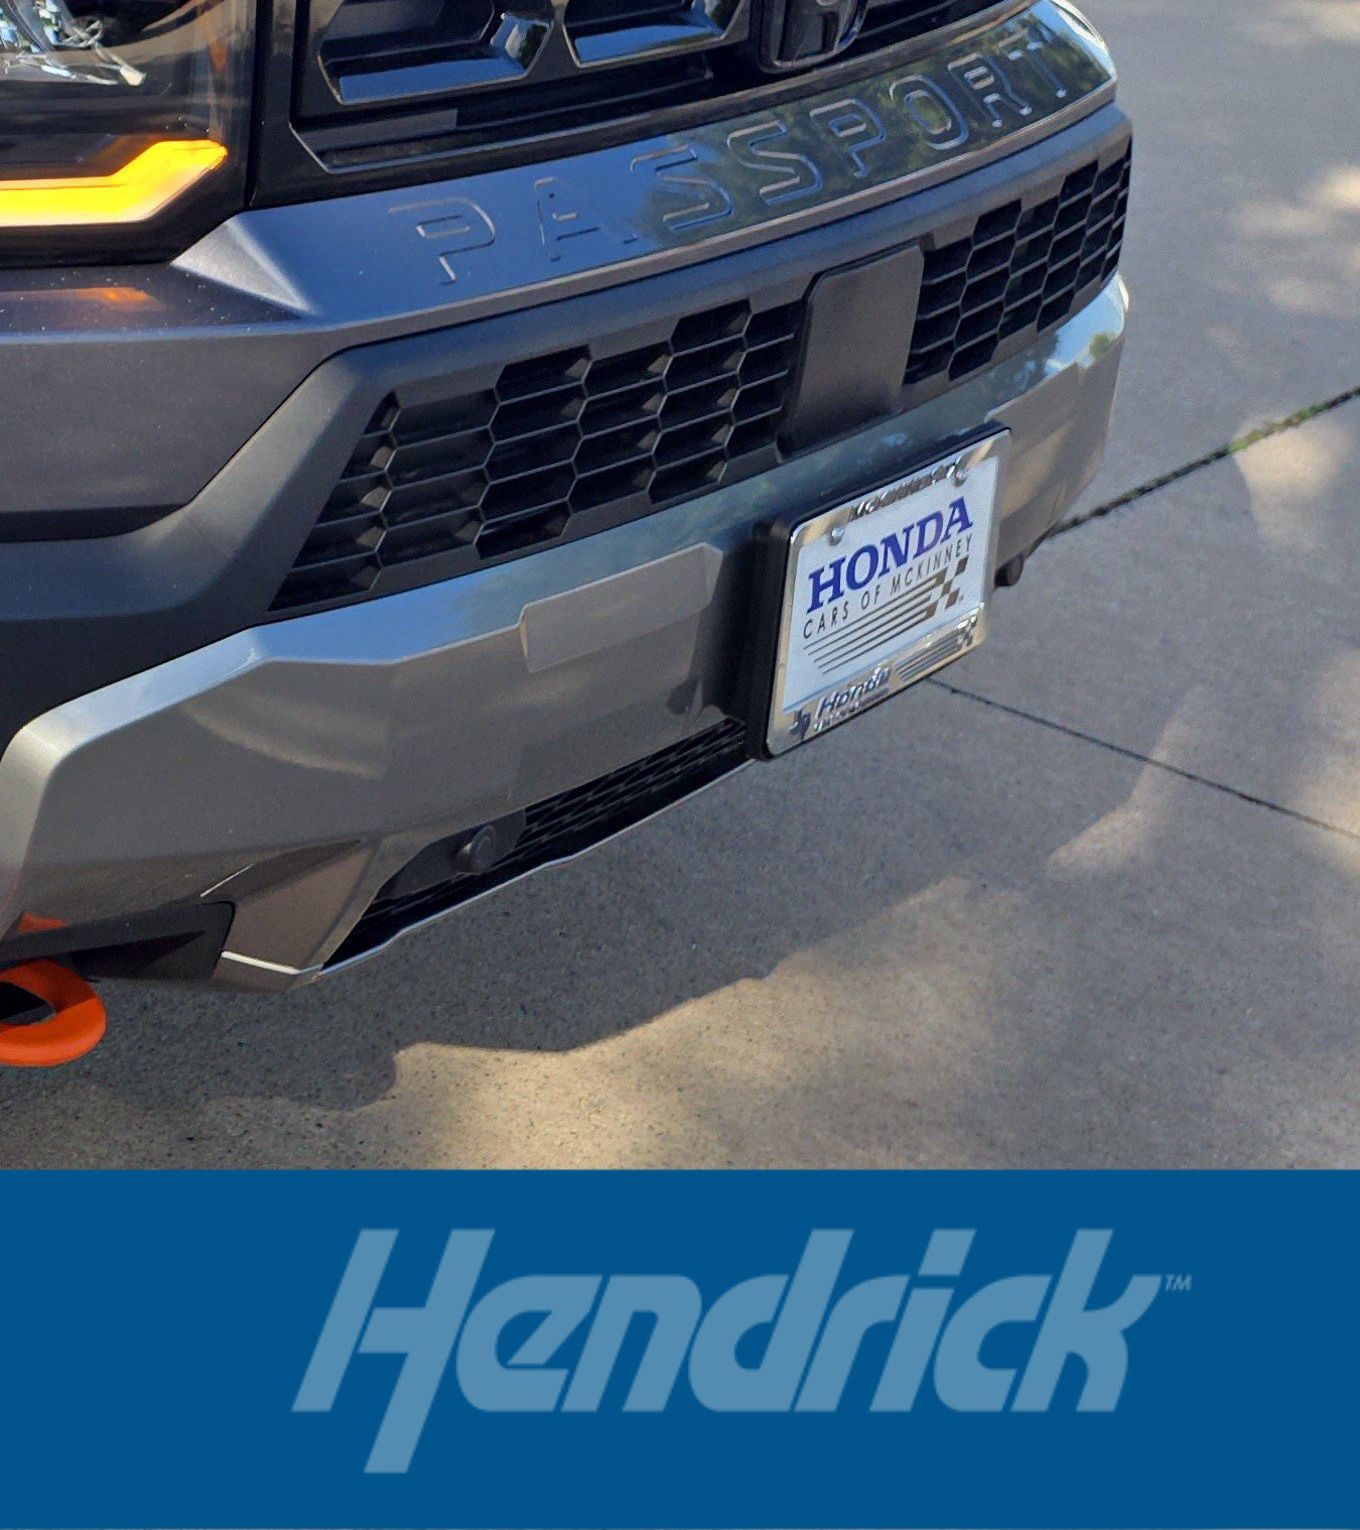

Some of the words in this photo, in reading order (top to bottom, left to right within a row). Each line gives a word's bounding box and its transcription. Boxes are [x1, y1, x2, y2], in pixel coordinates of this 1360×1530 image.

[387, 26, 1068, 286] PASSPORT
[803, 600, 849, 639] CARS
[860, 584, 881, 610] OF
[890, 532, 973, 596] MCKINNEY
[806, 496, 973, 614] HONDA
